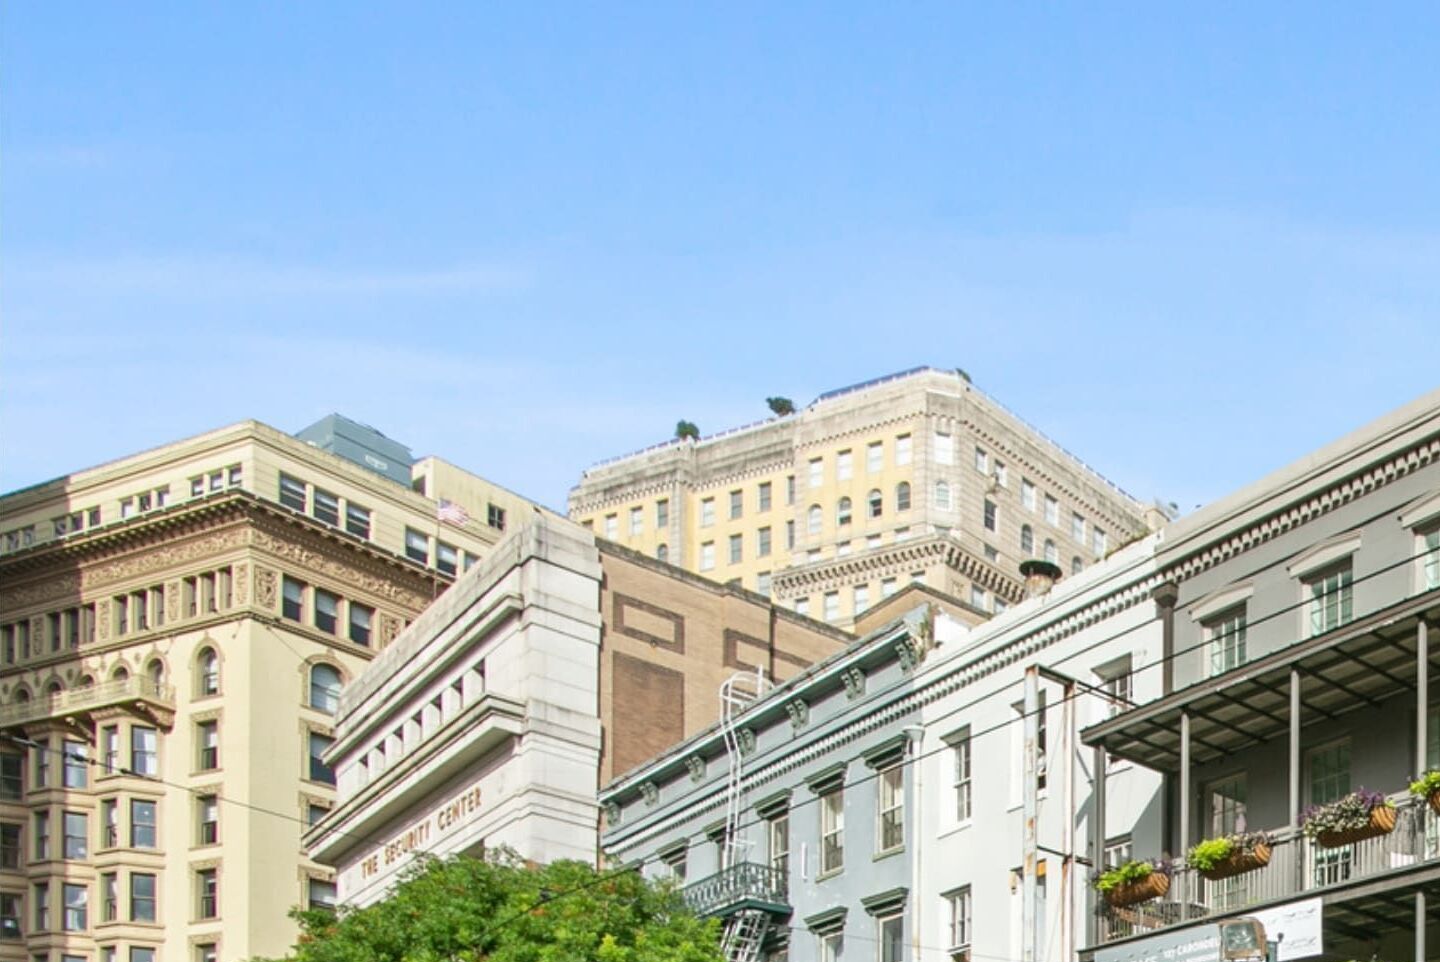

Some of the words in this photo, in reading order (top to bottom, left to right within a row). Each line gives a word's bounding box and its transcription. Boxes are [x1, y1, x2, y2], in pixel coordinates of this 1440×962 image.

[361, 855, 378, 880] THE
[384, 820, 431, 865] SECURITY
[437, 786, 482, 831] CENTER
